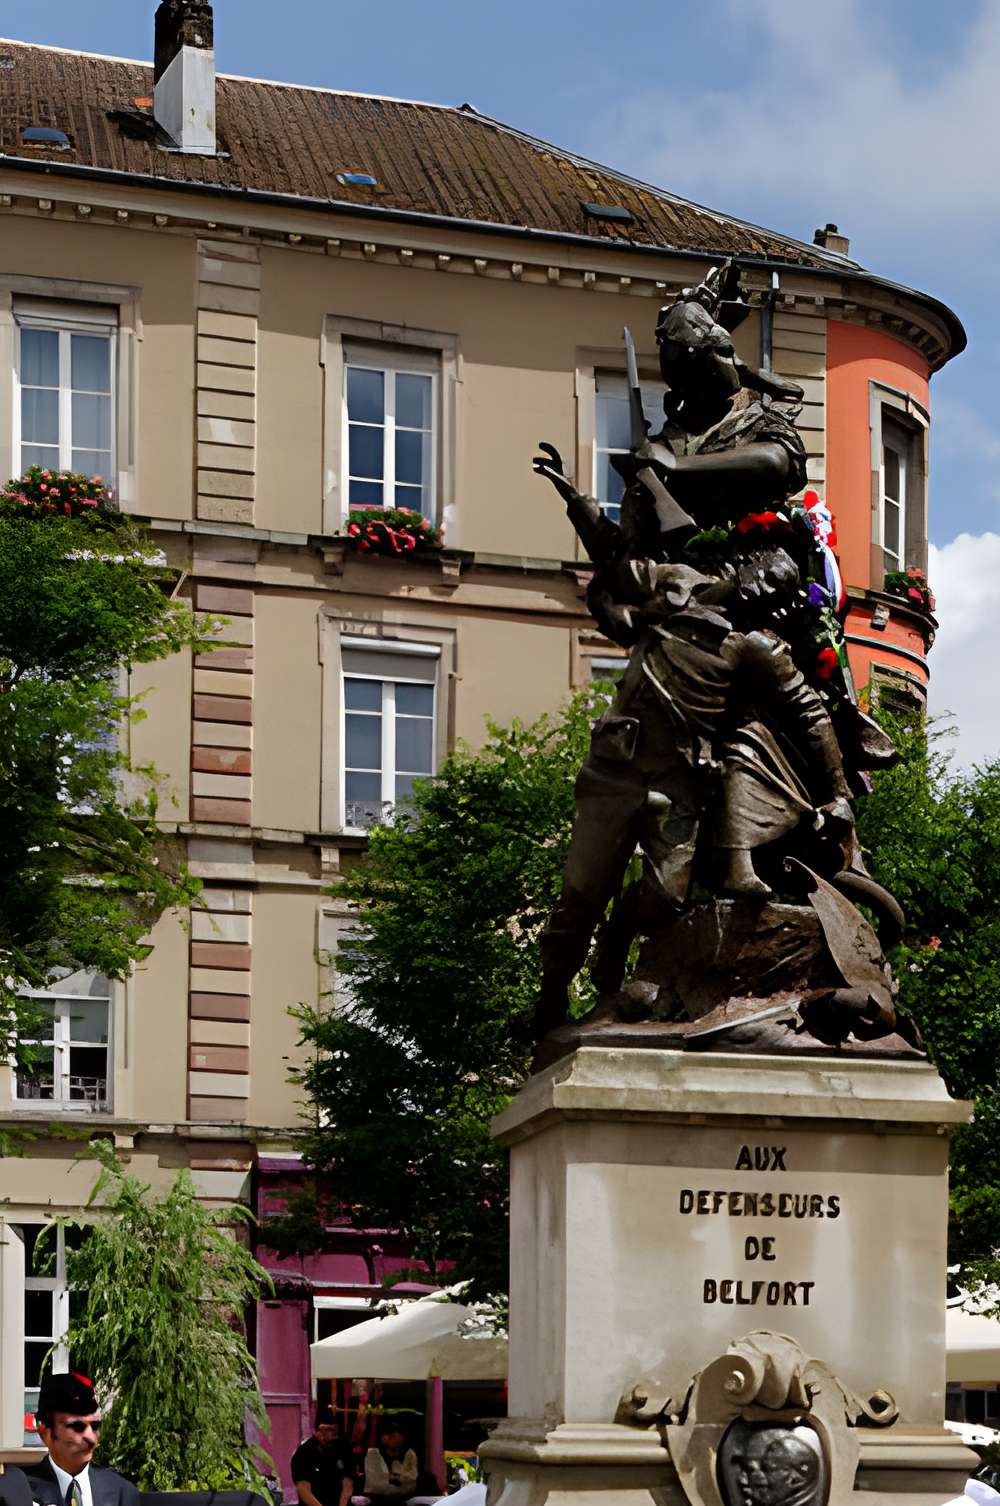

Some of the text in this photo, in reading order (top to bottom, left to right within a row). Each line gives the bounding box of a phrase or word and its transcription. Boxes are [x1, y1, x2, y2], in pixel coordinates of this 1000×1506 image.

[735, 1144, 787, 1171] AUX
[679, 1189, 840, 1218] DEFENSEURS
[744, 1236, 776, 1260] DE
[703, 1279, 815, 1305] BELFORT
